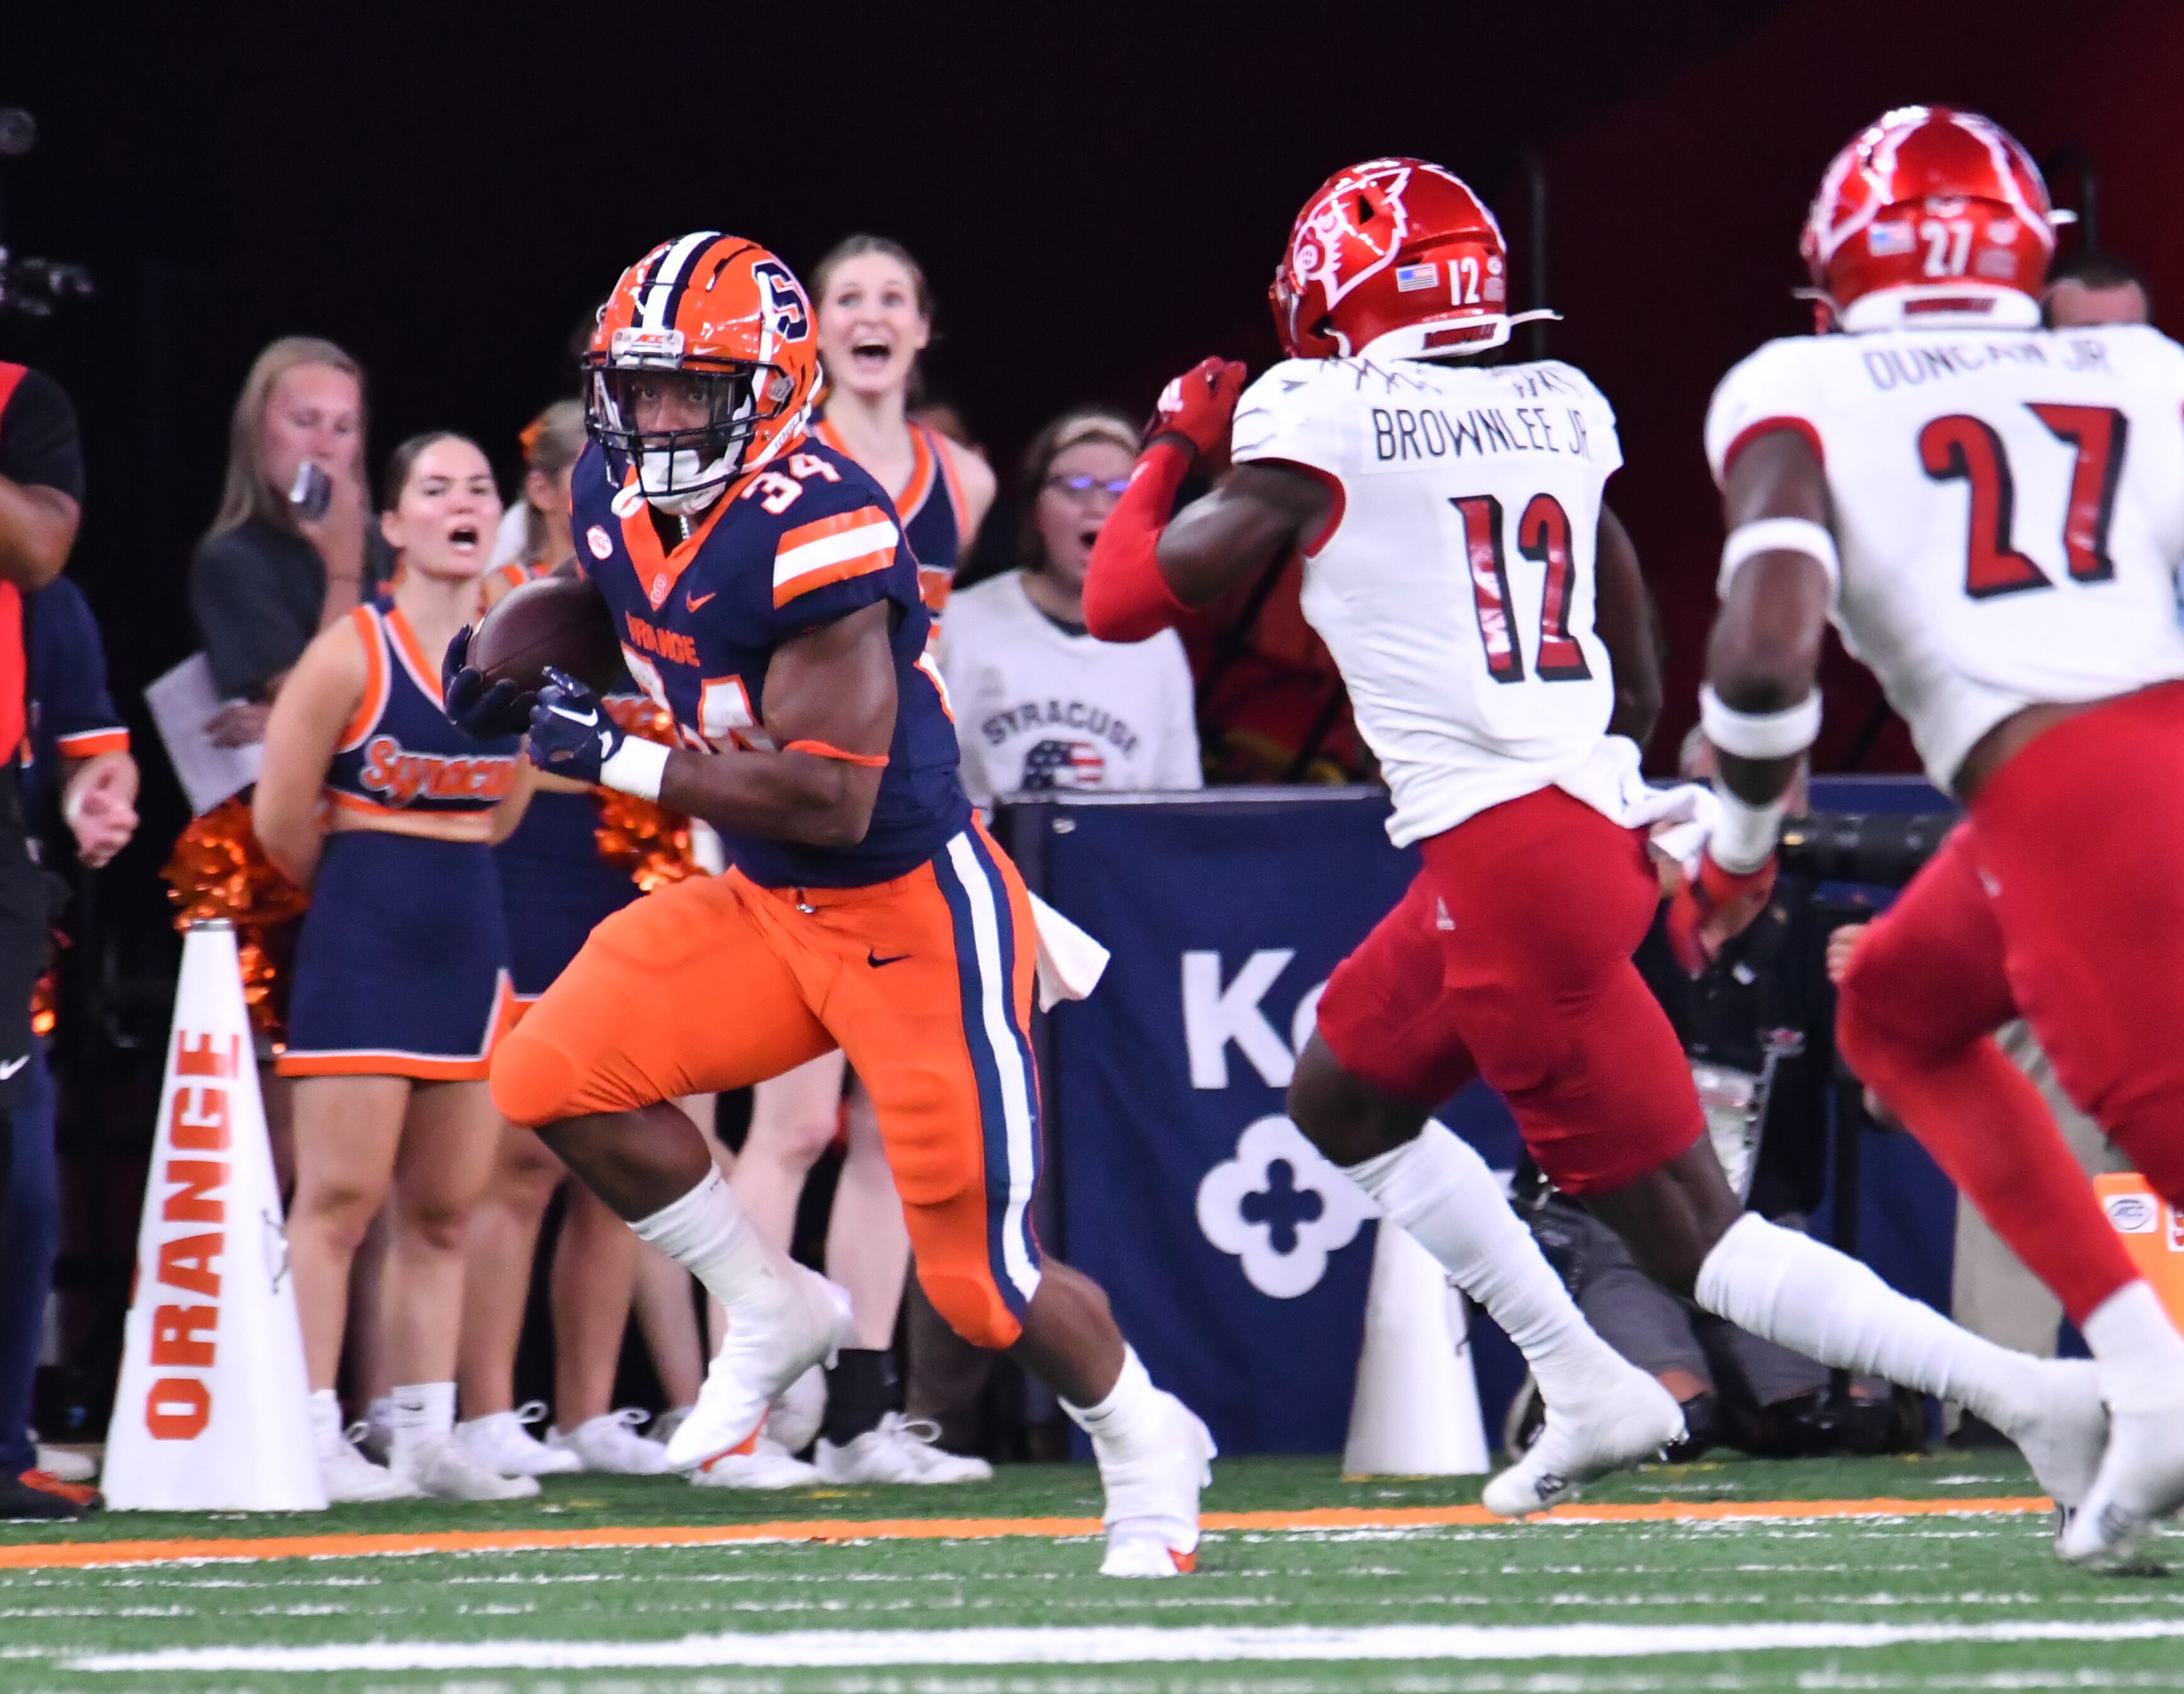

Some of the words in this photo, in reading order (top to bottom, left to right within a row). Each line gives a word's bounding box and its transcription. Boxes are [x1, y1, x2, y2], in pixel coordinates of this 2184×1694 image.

[1919, 220, 1973, 277] 27
[1447, 256, 1480, 307] 12
[1371, 407, 1560, 462] BROWNLEE
[740, 453, 842, 516] 34
[1917, 402, 2130, 602] 27
[1447, 492, 1594, 684] 12
[144, 1029, 241, 1440] ORANGE
